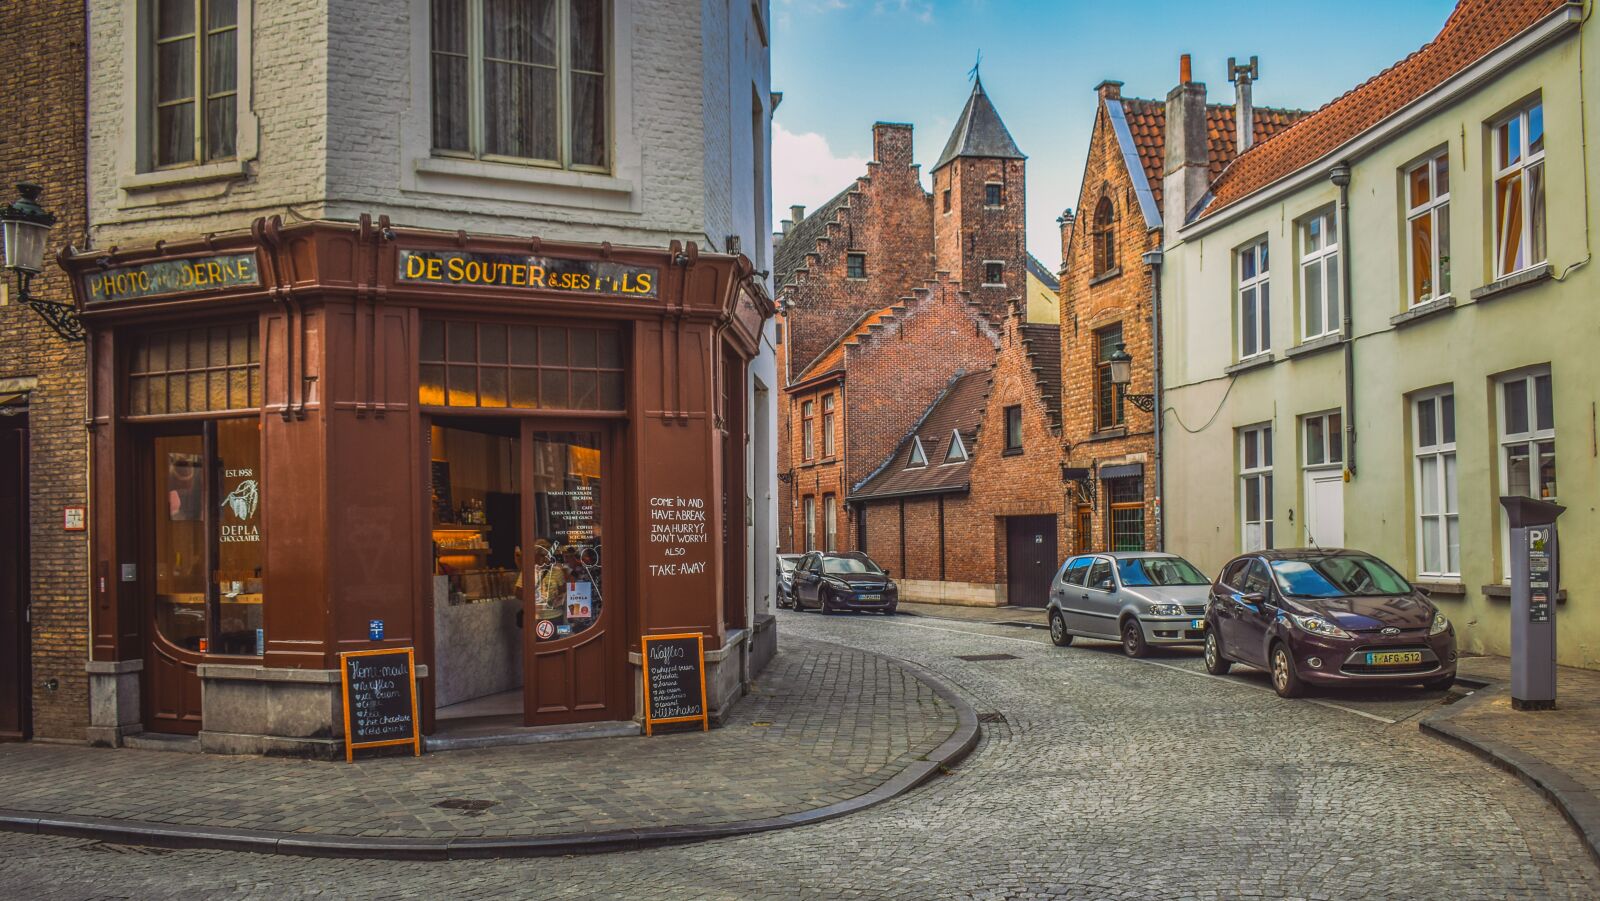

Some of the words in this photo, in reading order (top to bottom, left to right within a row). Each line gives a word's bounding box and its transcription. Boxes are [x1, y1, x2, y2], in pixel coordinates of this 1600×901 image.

[407, 255, 443, 279] DE
[447, 258, 546, 287] SOUTER
[561, 273, 590, 289] SES
[91, 271, 149, 297] PHOTO
[238, 468, 253, 477] 1958
[650, 497, 674, 507] COME
[687, 498, 704, 509] AND
[651, 509, 675, 520] HAVE
[675, 510, 682, 520] A
[681, 510, 706, 521] BREAK
[222, 525, 259, 536] DEPLA
[651, 524, 664, 533] IN
[663, 524, 671, 533] A
[671, 523, 705, 534] HURRY?
[650, 532, 675, 543] DON'T
[676, 532, 707, 543] WORRY!
[1529, 530, 1542, 549] P
[664, 547, 686, 556] ALSO
